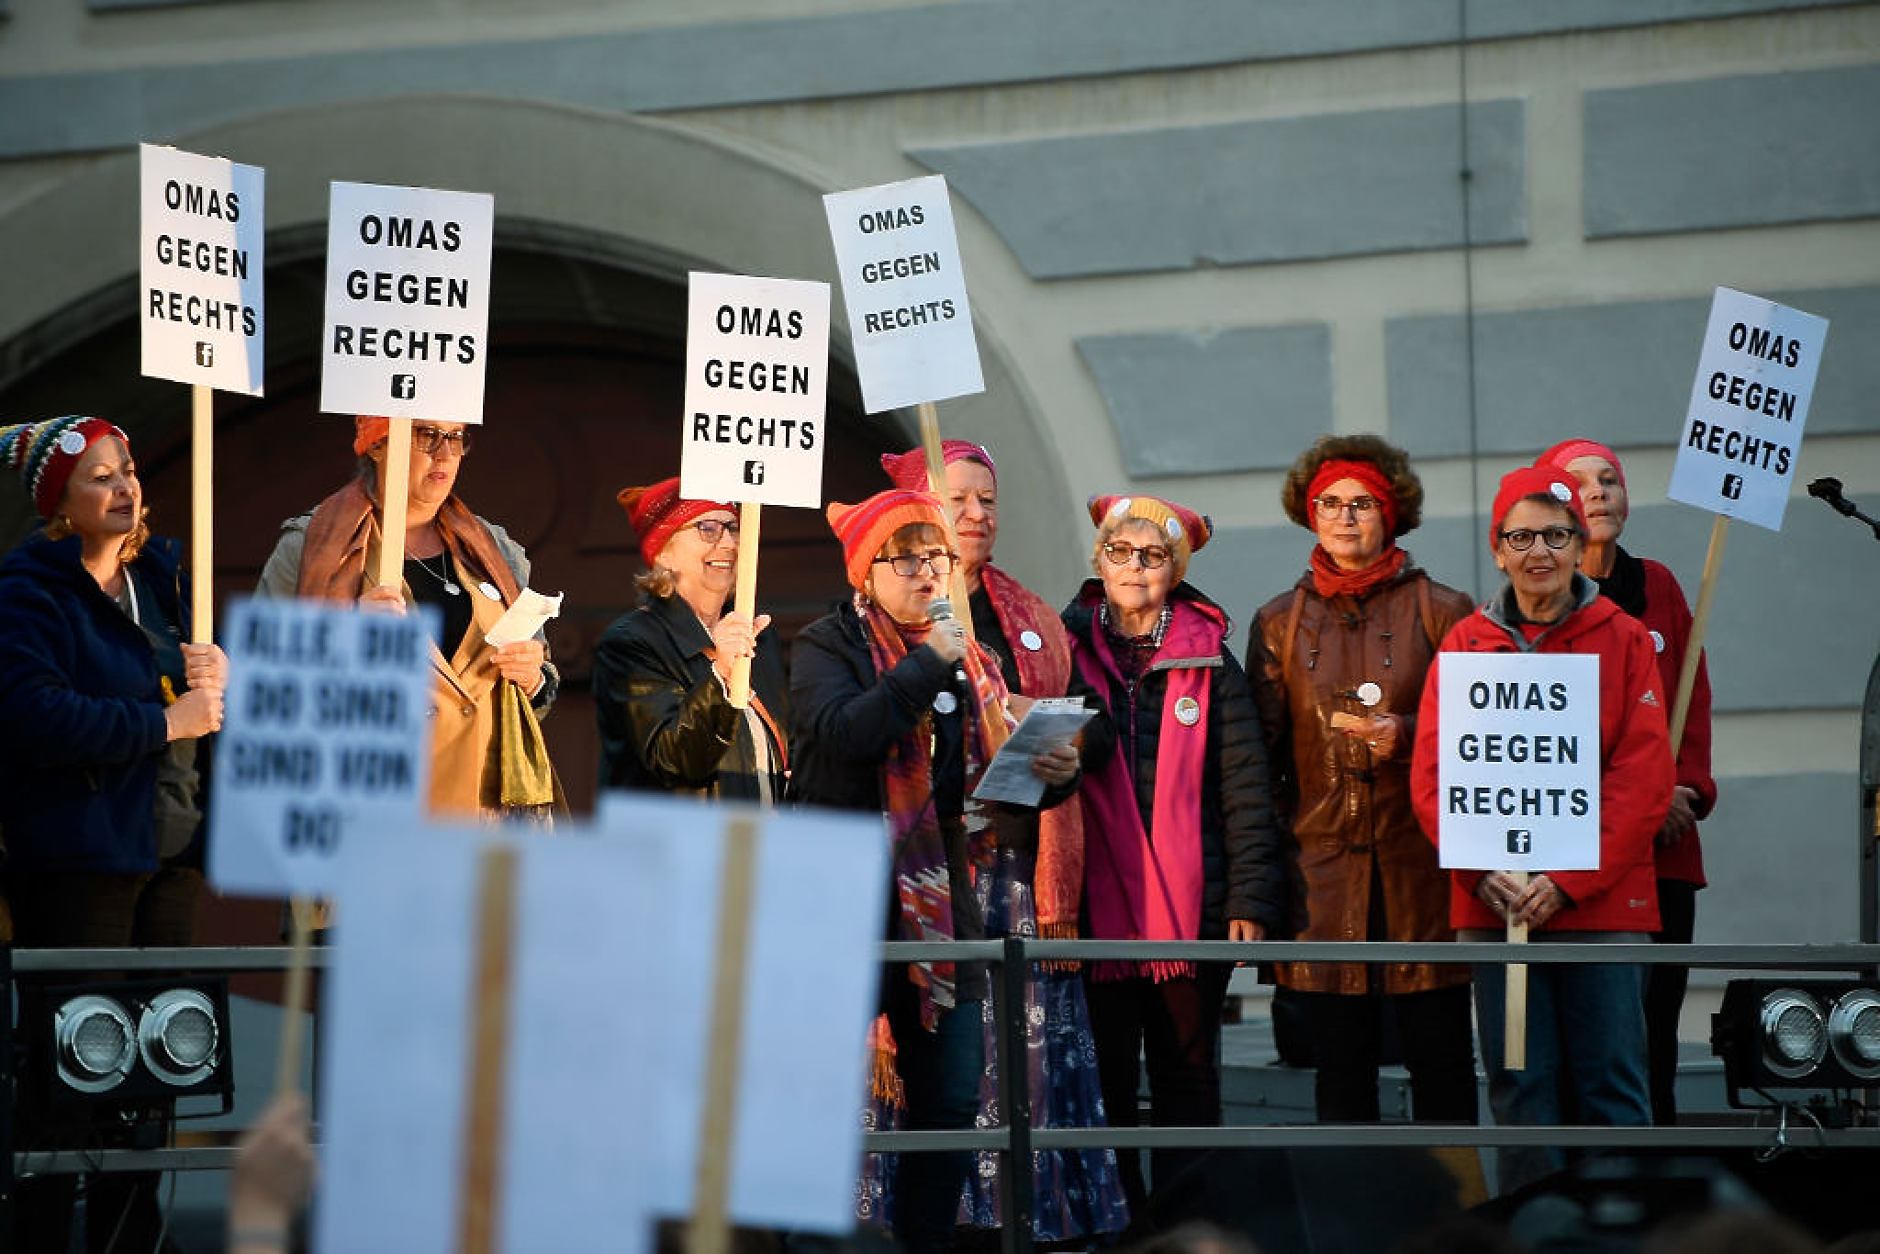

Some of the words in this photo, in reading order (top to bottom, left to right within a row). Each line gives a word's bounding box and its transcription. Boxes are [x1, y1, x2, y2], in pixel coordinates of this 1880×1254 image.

[165, 180, 239, 222] OMAS
[859, 206, 924, 233] OMAS
[360, 215, 461, 252] OMAS
[158, 235, 248, 279] GEGEN
[863, 252, 940, 283] GEGEN
[347, 270, 468, 308] GEGEN
[150, 288, 255, 336] RECHTS
[716, 305, 802, 339] OMAS
[865, 299, 955, 333] RECHTS
[334, 325, 474, 364] RECHTS
[1729, 323, 1800, 367] OMAS
[705, 360, 808, 395] GEGEN
[1709, 372, 1796, 422] GEGEN
[694, 413, 813, 450] RECHTS
[1689, 420, 1790, 475] RECHTS
[1470, 681, 1566, 711] OMAS
[1459, 734, 1577, 764] GEGEN
[1450, 786, 1588, 815] RECHTS
